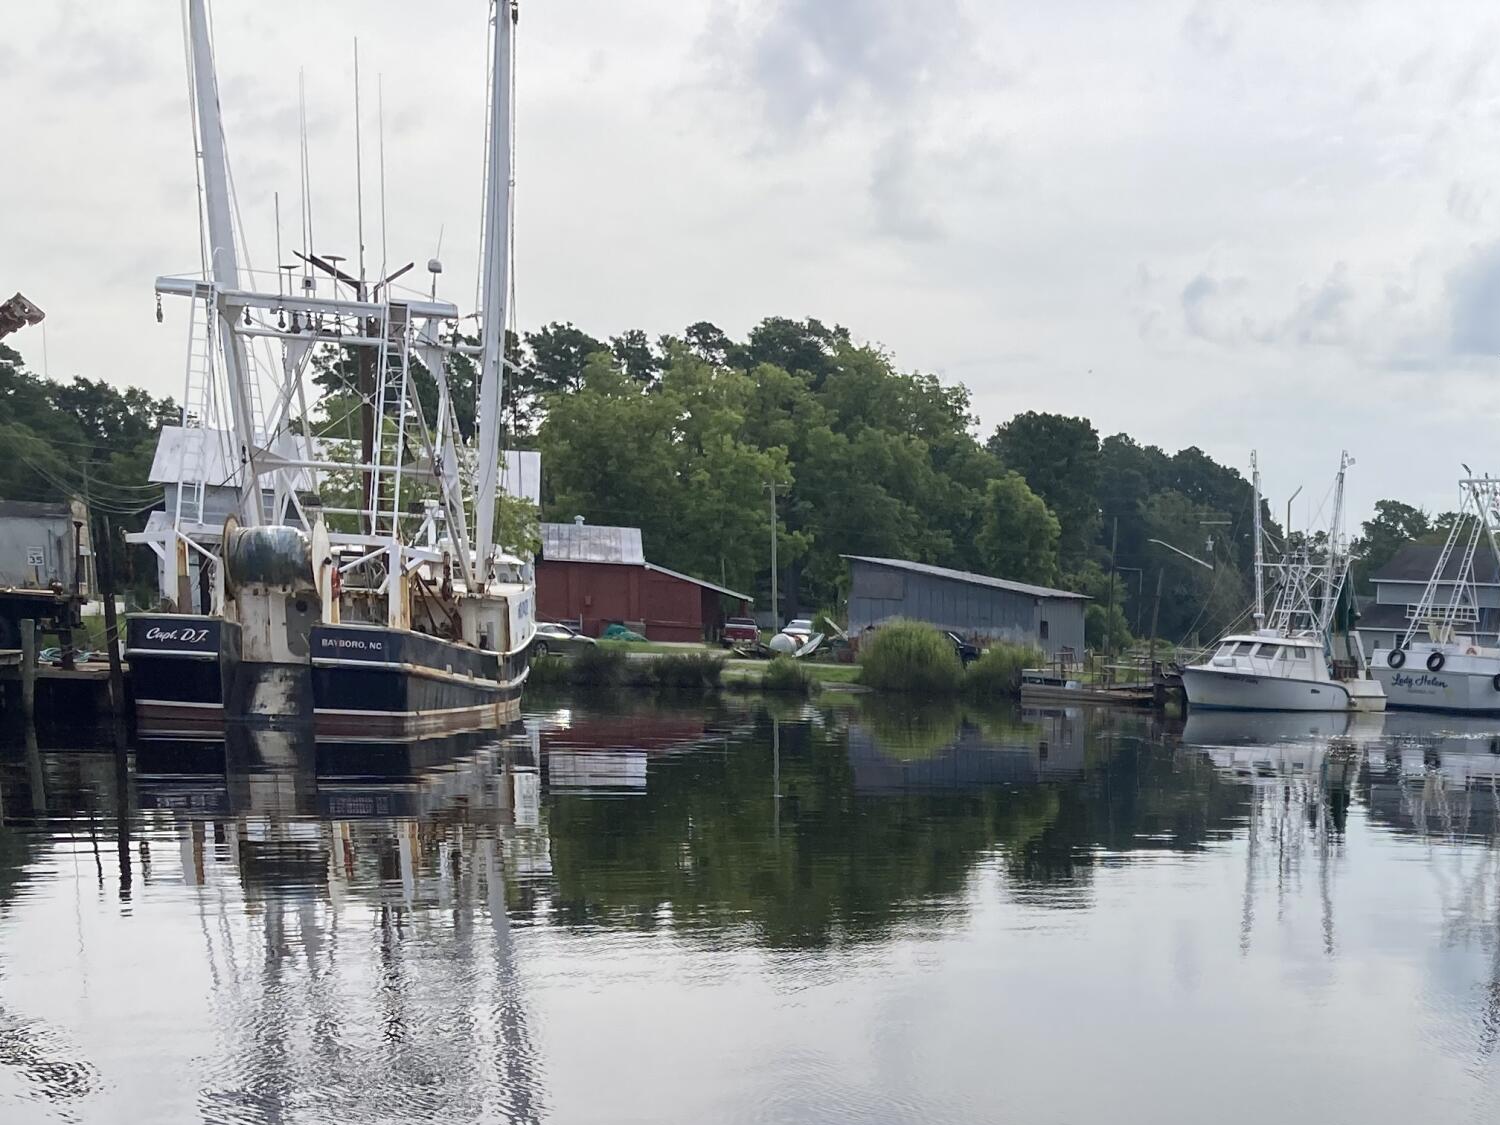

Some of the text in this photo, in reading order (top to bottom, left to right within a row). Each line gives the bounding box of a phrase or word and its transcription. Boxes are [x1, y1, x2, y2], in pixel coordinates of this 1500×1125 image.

[368, 641, 383, 650] NC
[1391, 672, 1448, 688] Lady Helen
